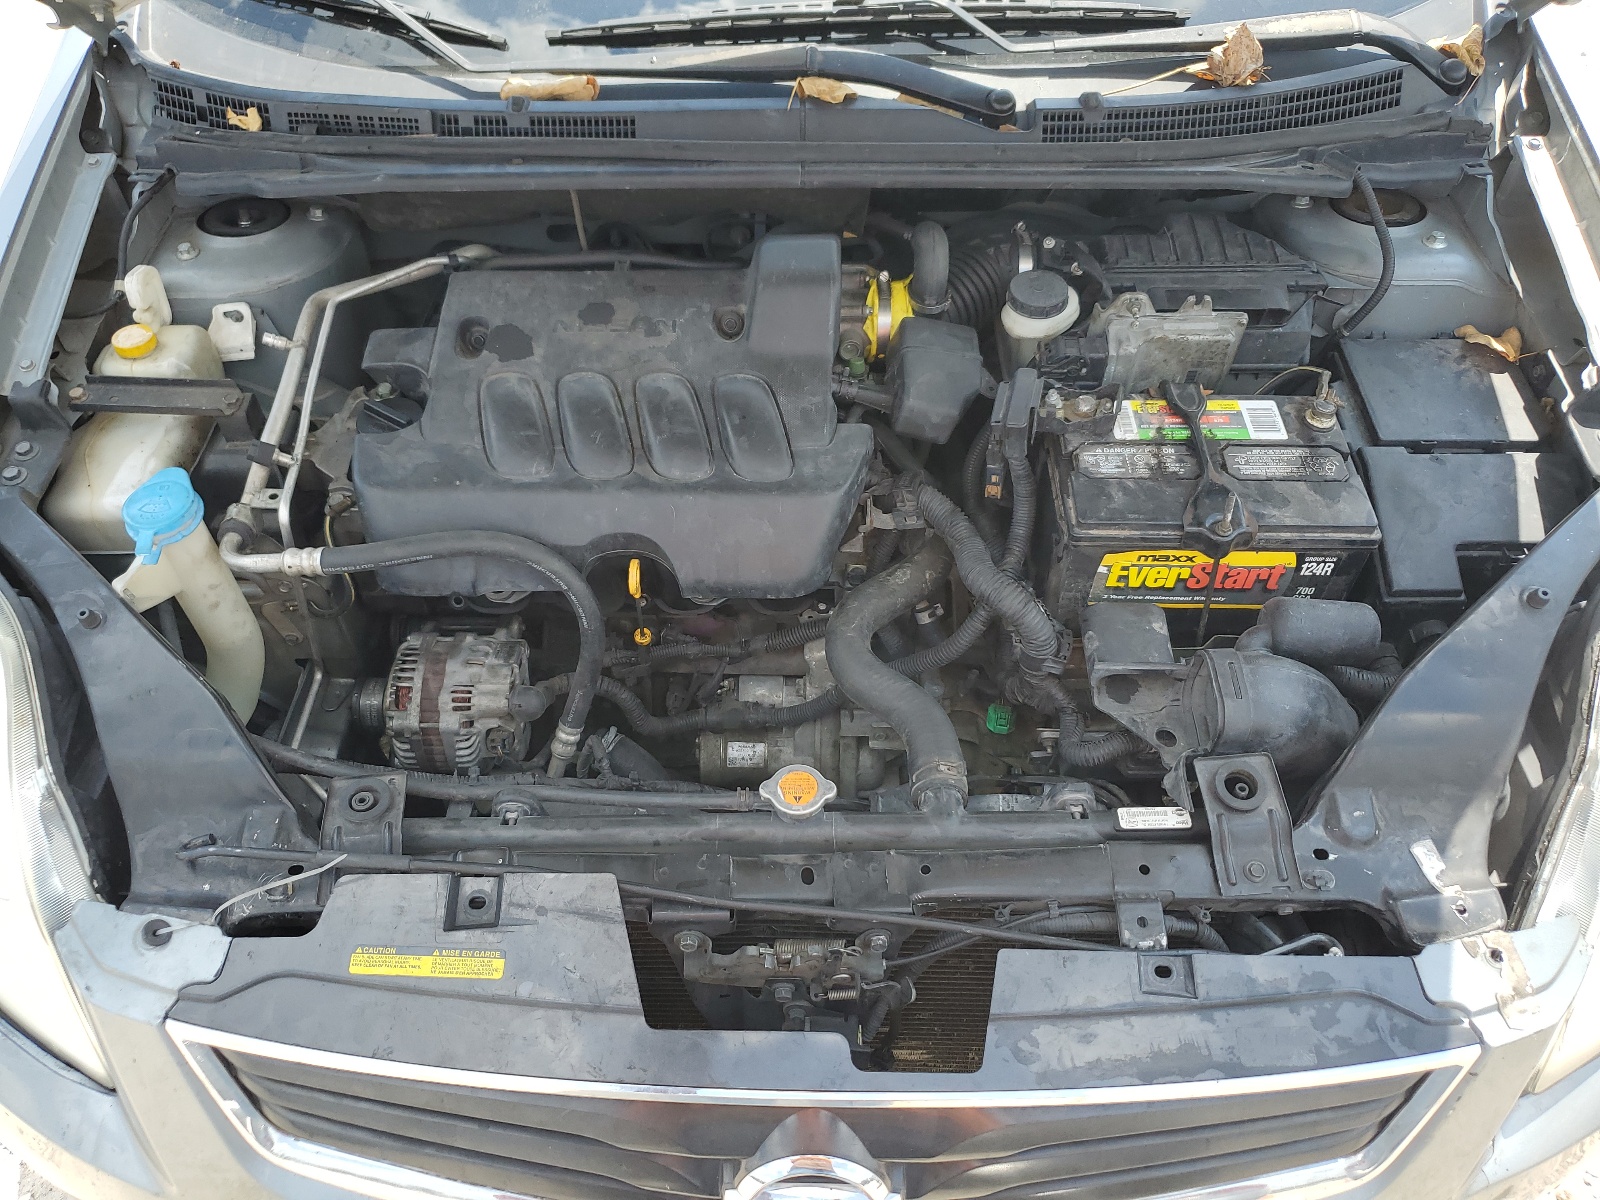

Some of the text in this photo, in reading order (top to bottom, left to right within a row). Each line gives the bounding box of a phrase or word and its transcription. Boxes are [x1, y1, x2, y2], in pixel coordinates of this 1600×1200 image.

[1137, 554, 1198, 563] maxx
[1300, 562, 1335, 576] 124R
[1105, 561, 1286, 590] EverStart
[1295, 586, 1315, 595] 700
[1144, 594, 1193, 602] Replacement
[363, 946, 397, 954] CAUTION
[441, 949, 461, 957] MISE
